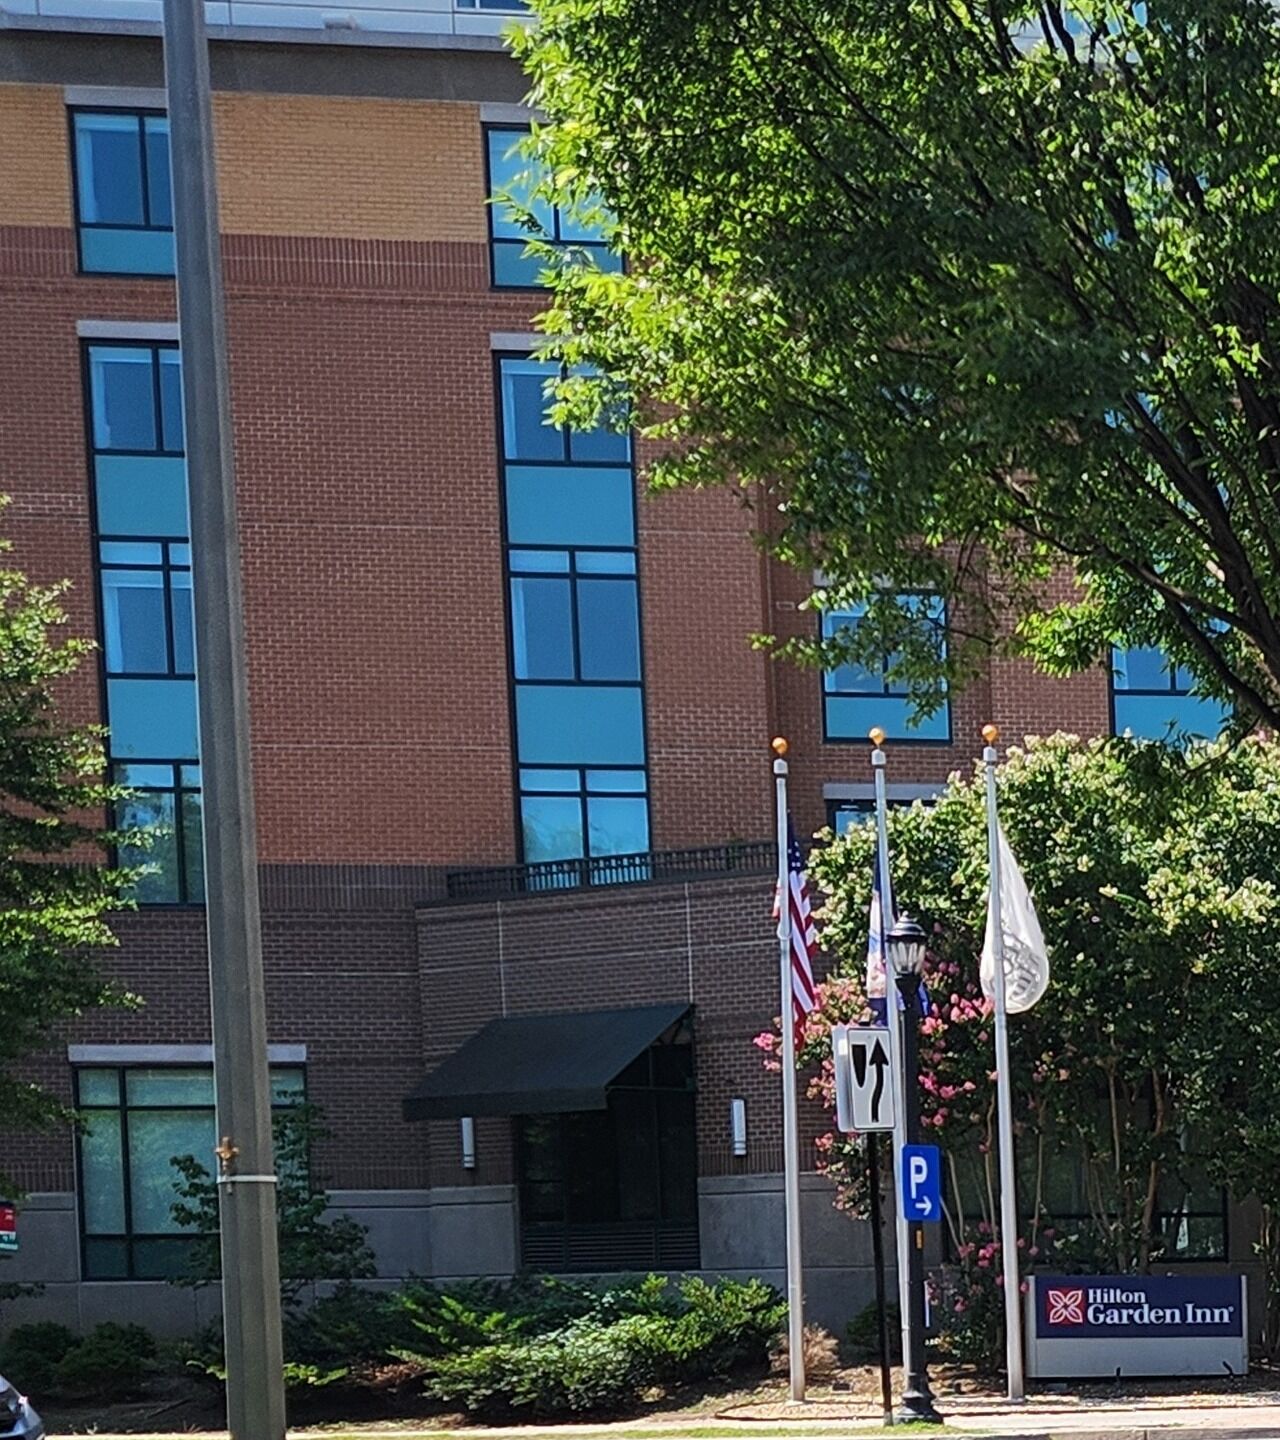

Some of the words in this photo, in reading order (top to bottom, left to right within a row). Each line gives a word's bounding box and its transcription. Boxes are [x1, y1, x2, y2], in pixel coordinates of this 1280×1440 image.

[910, 1156, 928, 1199] P
[1088, 1288, 1146, 1304] Hilton
[1087, 1304, 1182, 1324] Garden
[1186, 1304, 1231, 1324] Inn
